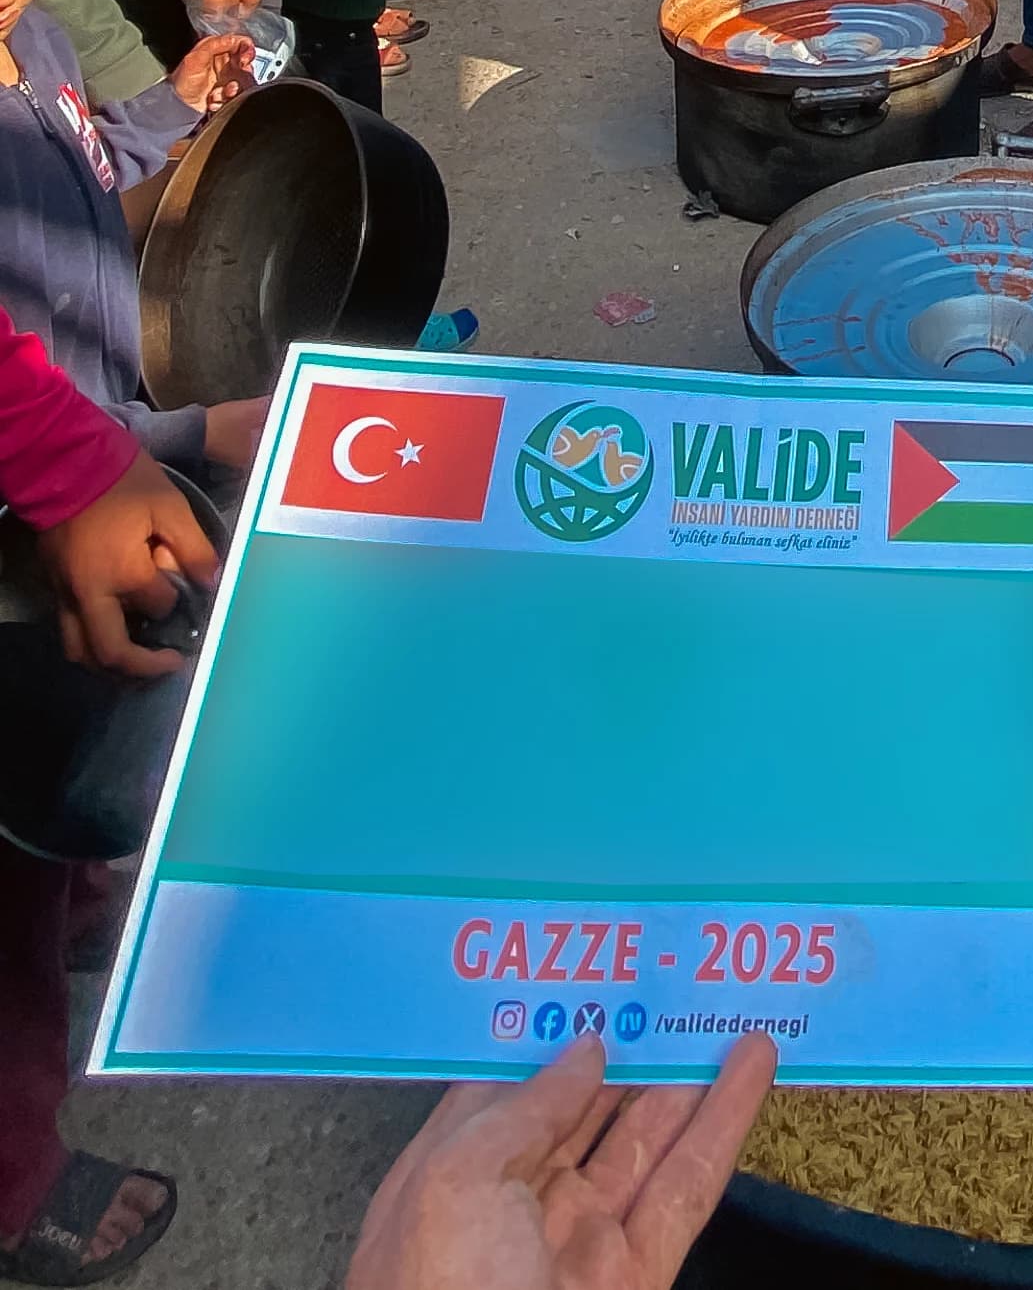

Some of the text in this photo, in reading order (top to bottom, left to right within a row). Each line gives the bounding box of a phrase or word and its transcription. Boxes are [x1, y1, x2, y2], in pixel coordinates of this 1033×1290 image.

[730, 503, 790, 530] YARDIM
[452, 918, 644, 983] GAZZE
[695, 922, 836, 984] 2025
